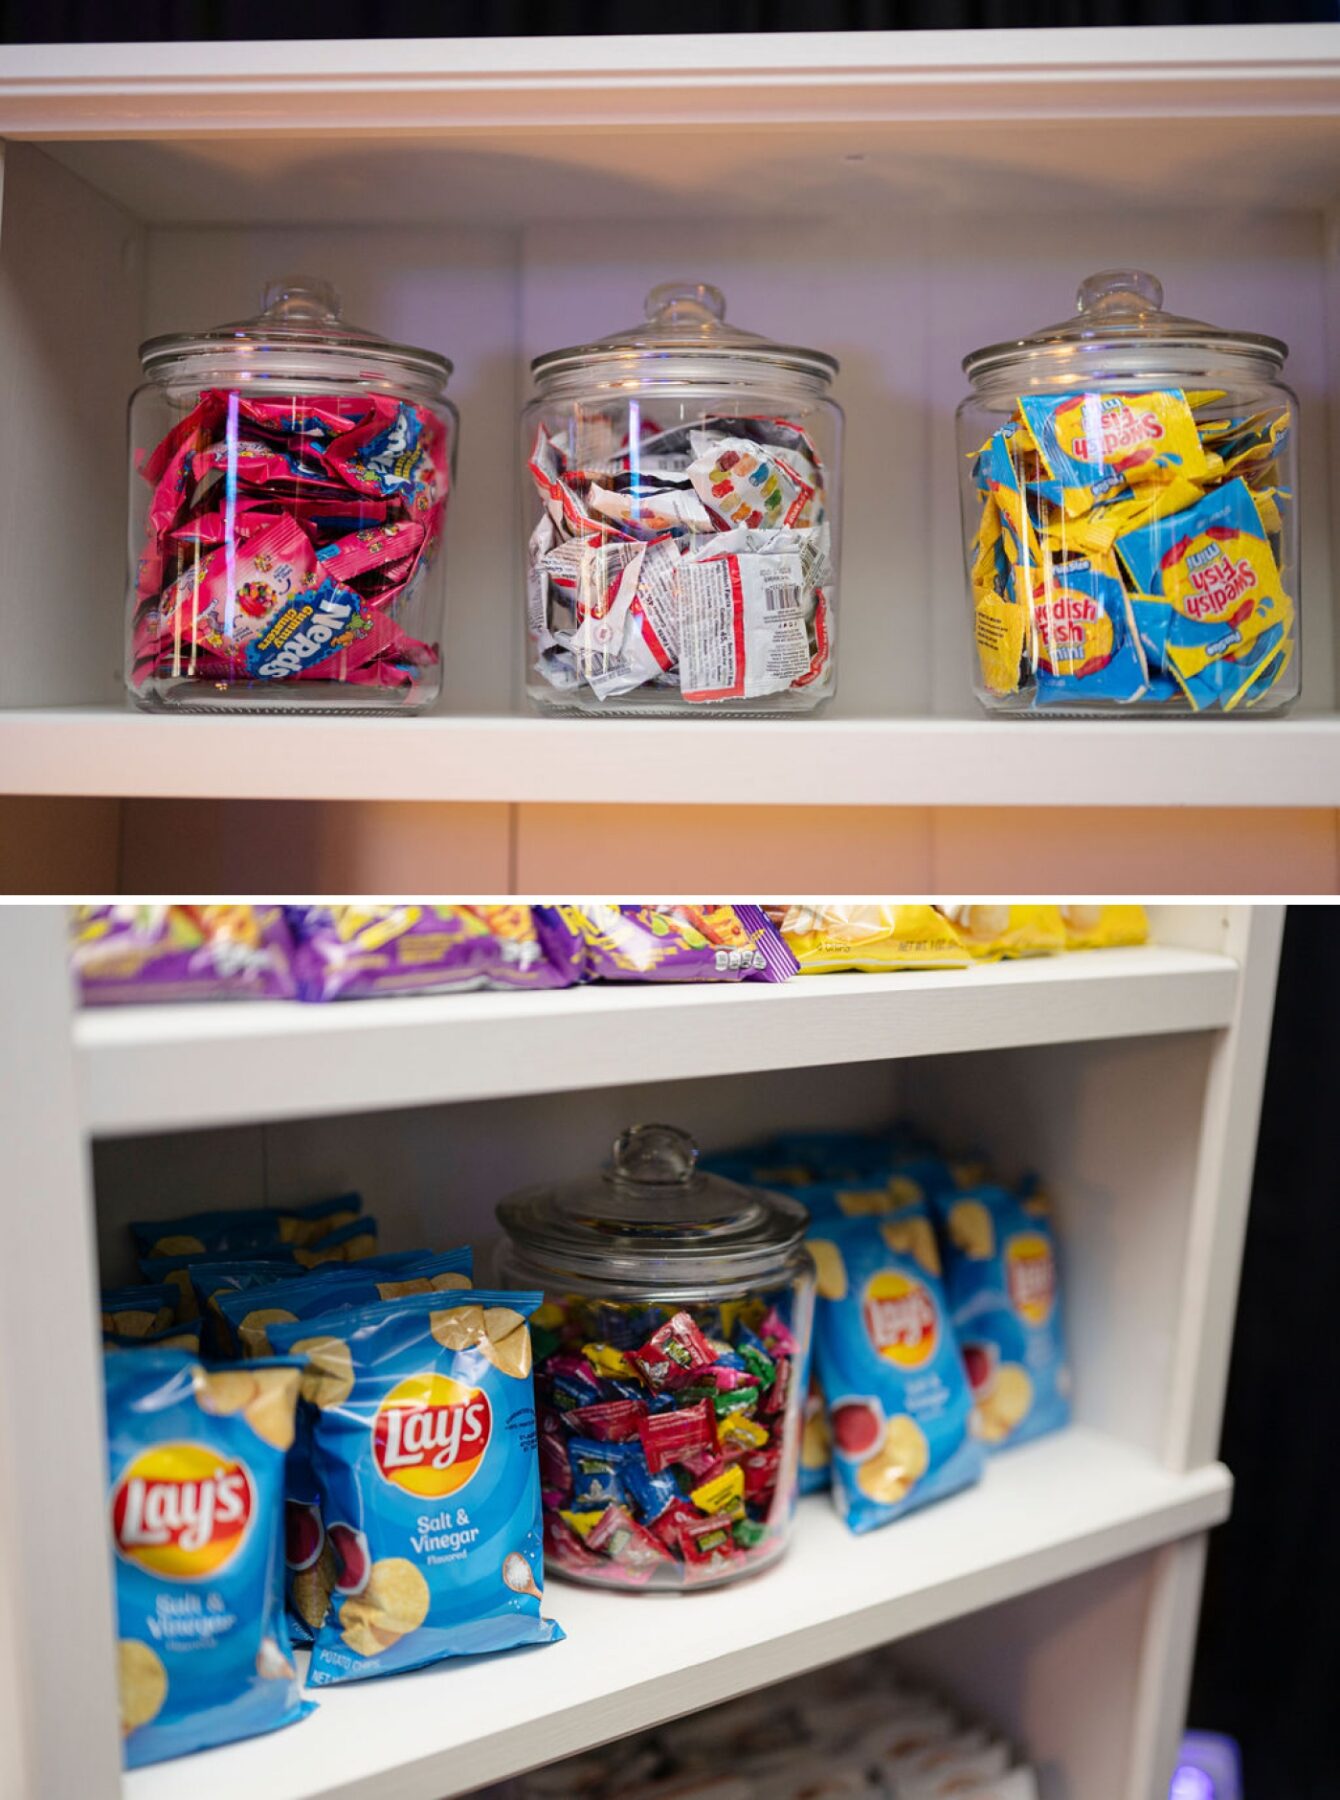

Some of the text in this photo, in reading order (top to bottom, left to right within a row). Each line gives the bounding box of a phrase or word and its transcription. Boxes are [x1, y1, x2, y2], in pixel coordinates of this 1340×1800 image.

[1073, 414, 1164, 460] Swedsh
[1082, 406, 1135, 430] Fis
[1184, 559, 1257, 620] Swedish
[1191, 554, 1237, 592] Fish
[257, 607, 298, 652] Clusters
[273, 605, 315, 650] Gummy
[383, 1395, 485, 1471] Lay's
[119, 1466, 246, 1552] Lay's
[417, 1507, 471, 1535] Salt &
[409, 1527, 480, 1555] Vinegar
